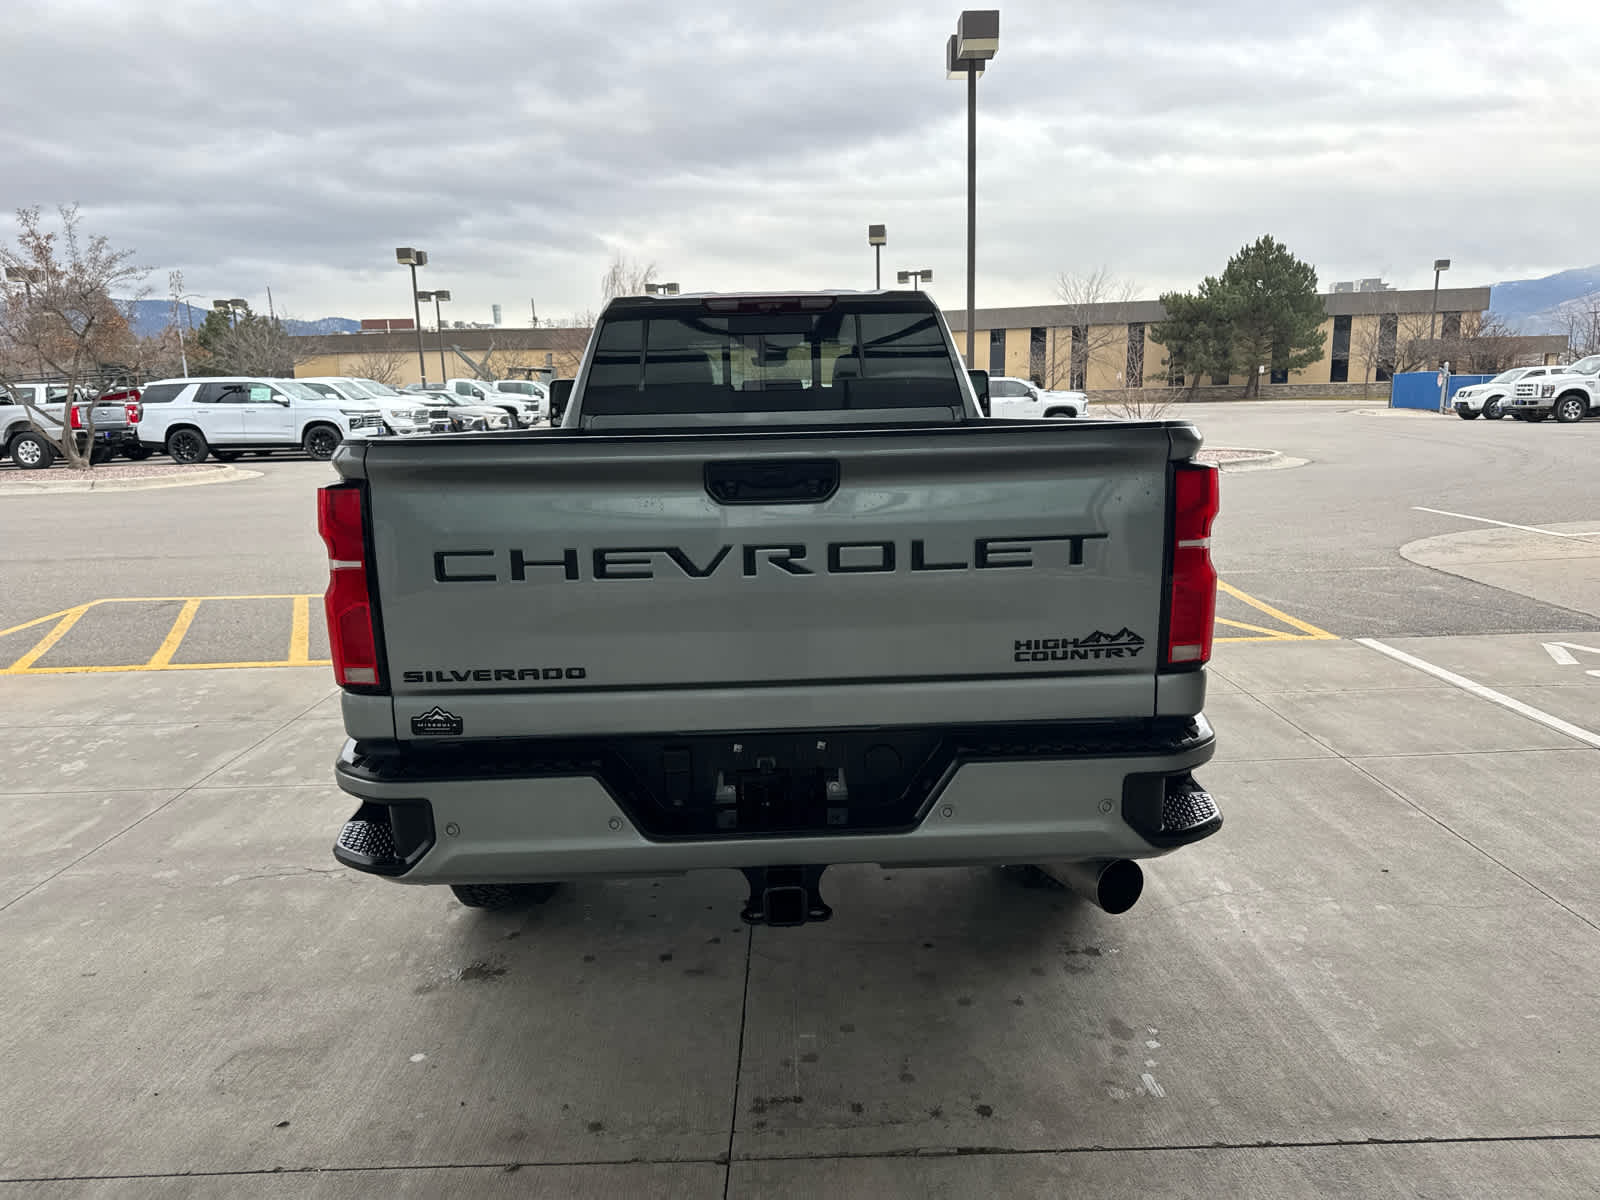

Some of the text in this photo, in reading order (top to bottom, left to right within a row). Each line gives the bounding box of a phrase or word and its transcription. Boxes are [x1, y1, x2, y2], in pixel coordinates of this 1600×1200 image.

[434, 533, 1109, 582] CHEVROLET
[1014, 638, 1079, 650] HIGH
[1014, 646, 1144, 662] COUNTRY
[403, 667, 586, 683] SILVERADO
